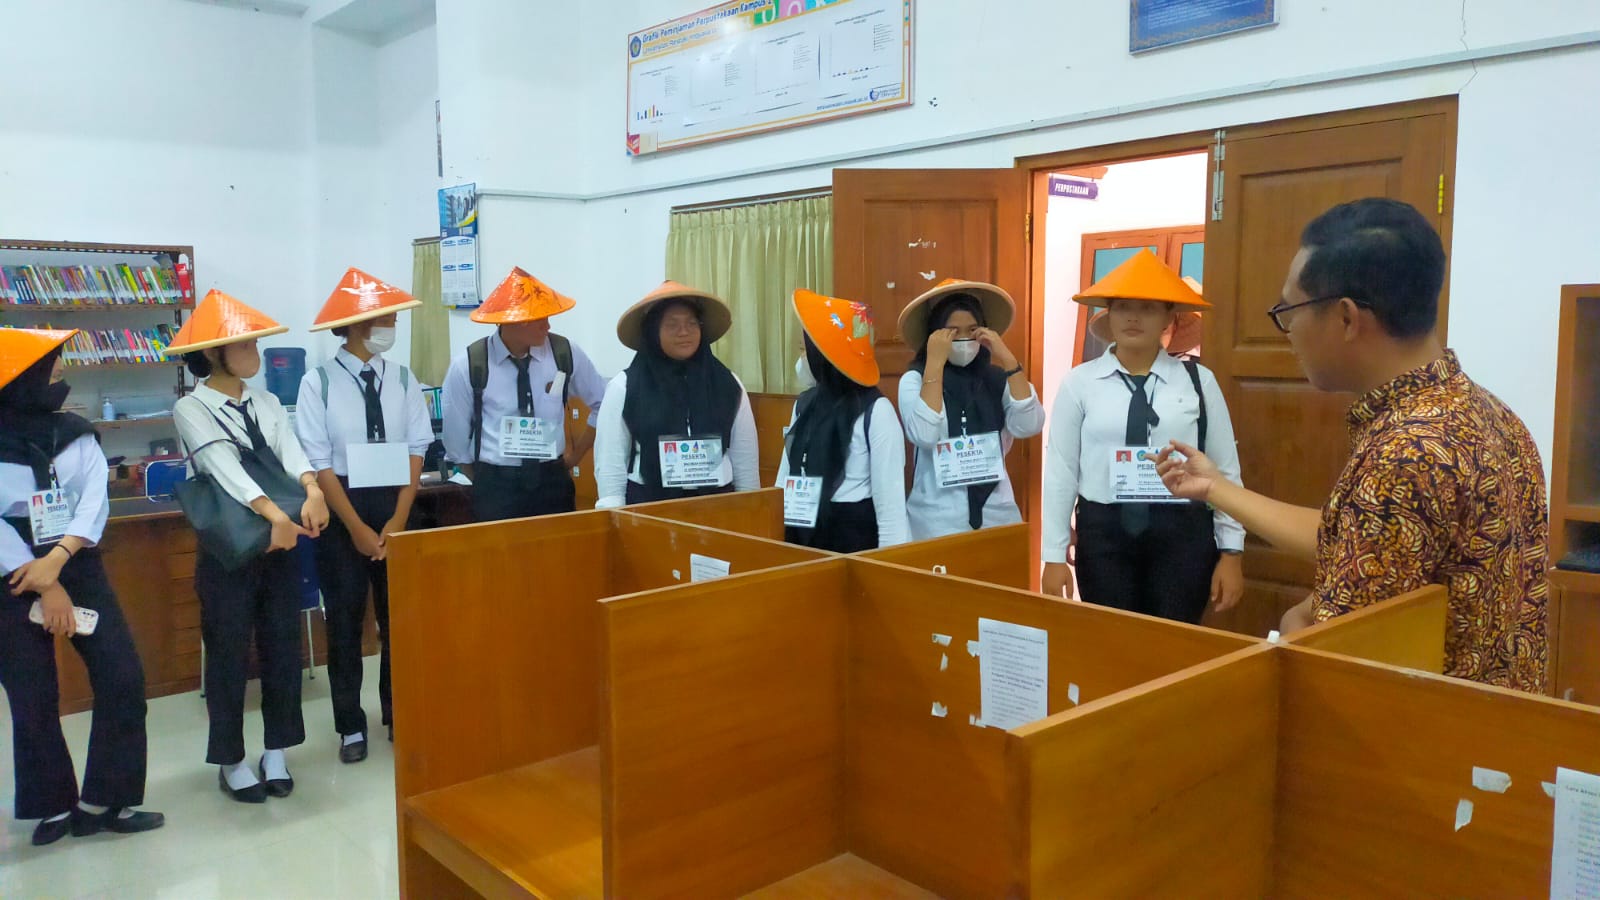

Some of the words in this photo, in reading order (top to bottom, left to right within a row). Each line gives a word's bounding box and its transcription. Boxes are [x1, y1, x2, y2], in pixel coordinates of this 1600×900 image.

[660, 20, 695, 37] Peminjaman
[696, 7, 739, 27] Perpustakaan
[1055, 182, 1089, 196] PERPUSTAKAAN
[956, 449, 984, 459] PESERTA
